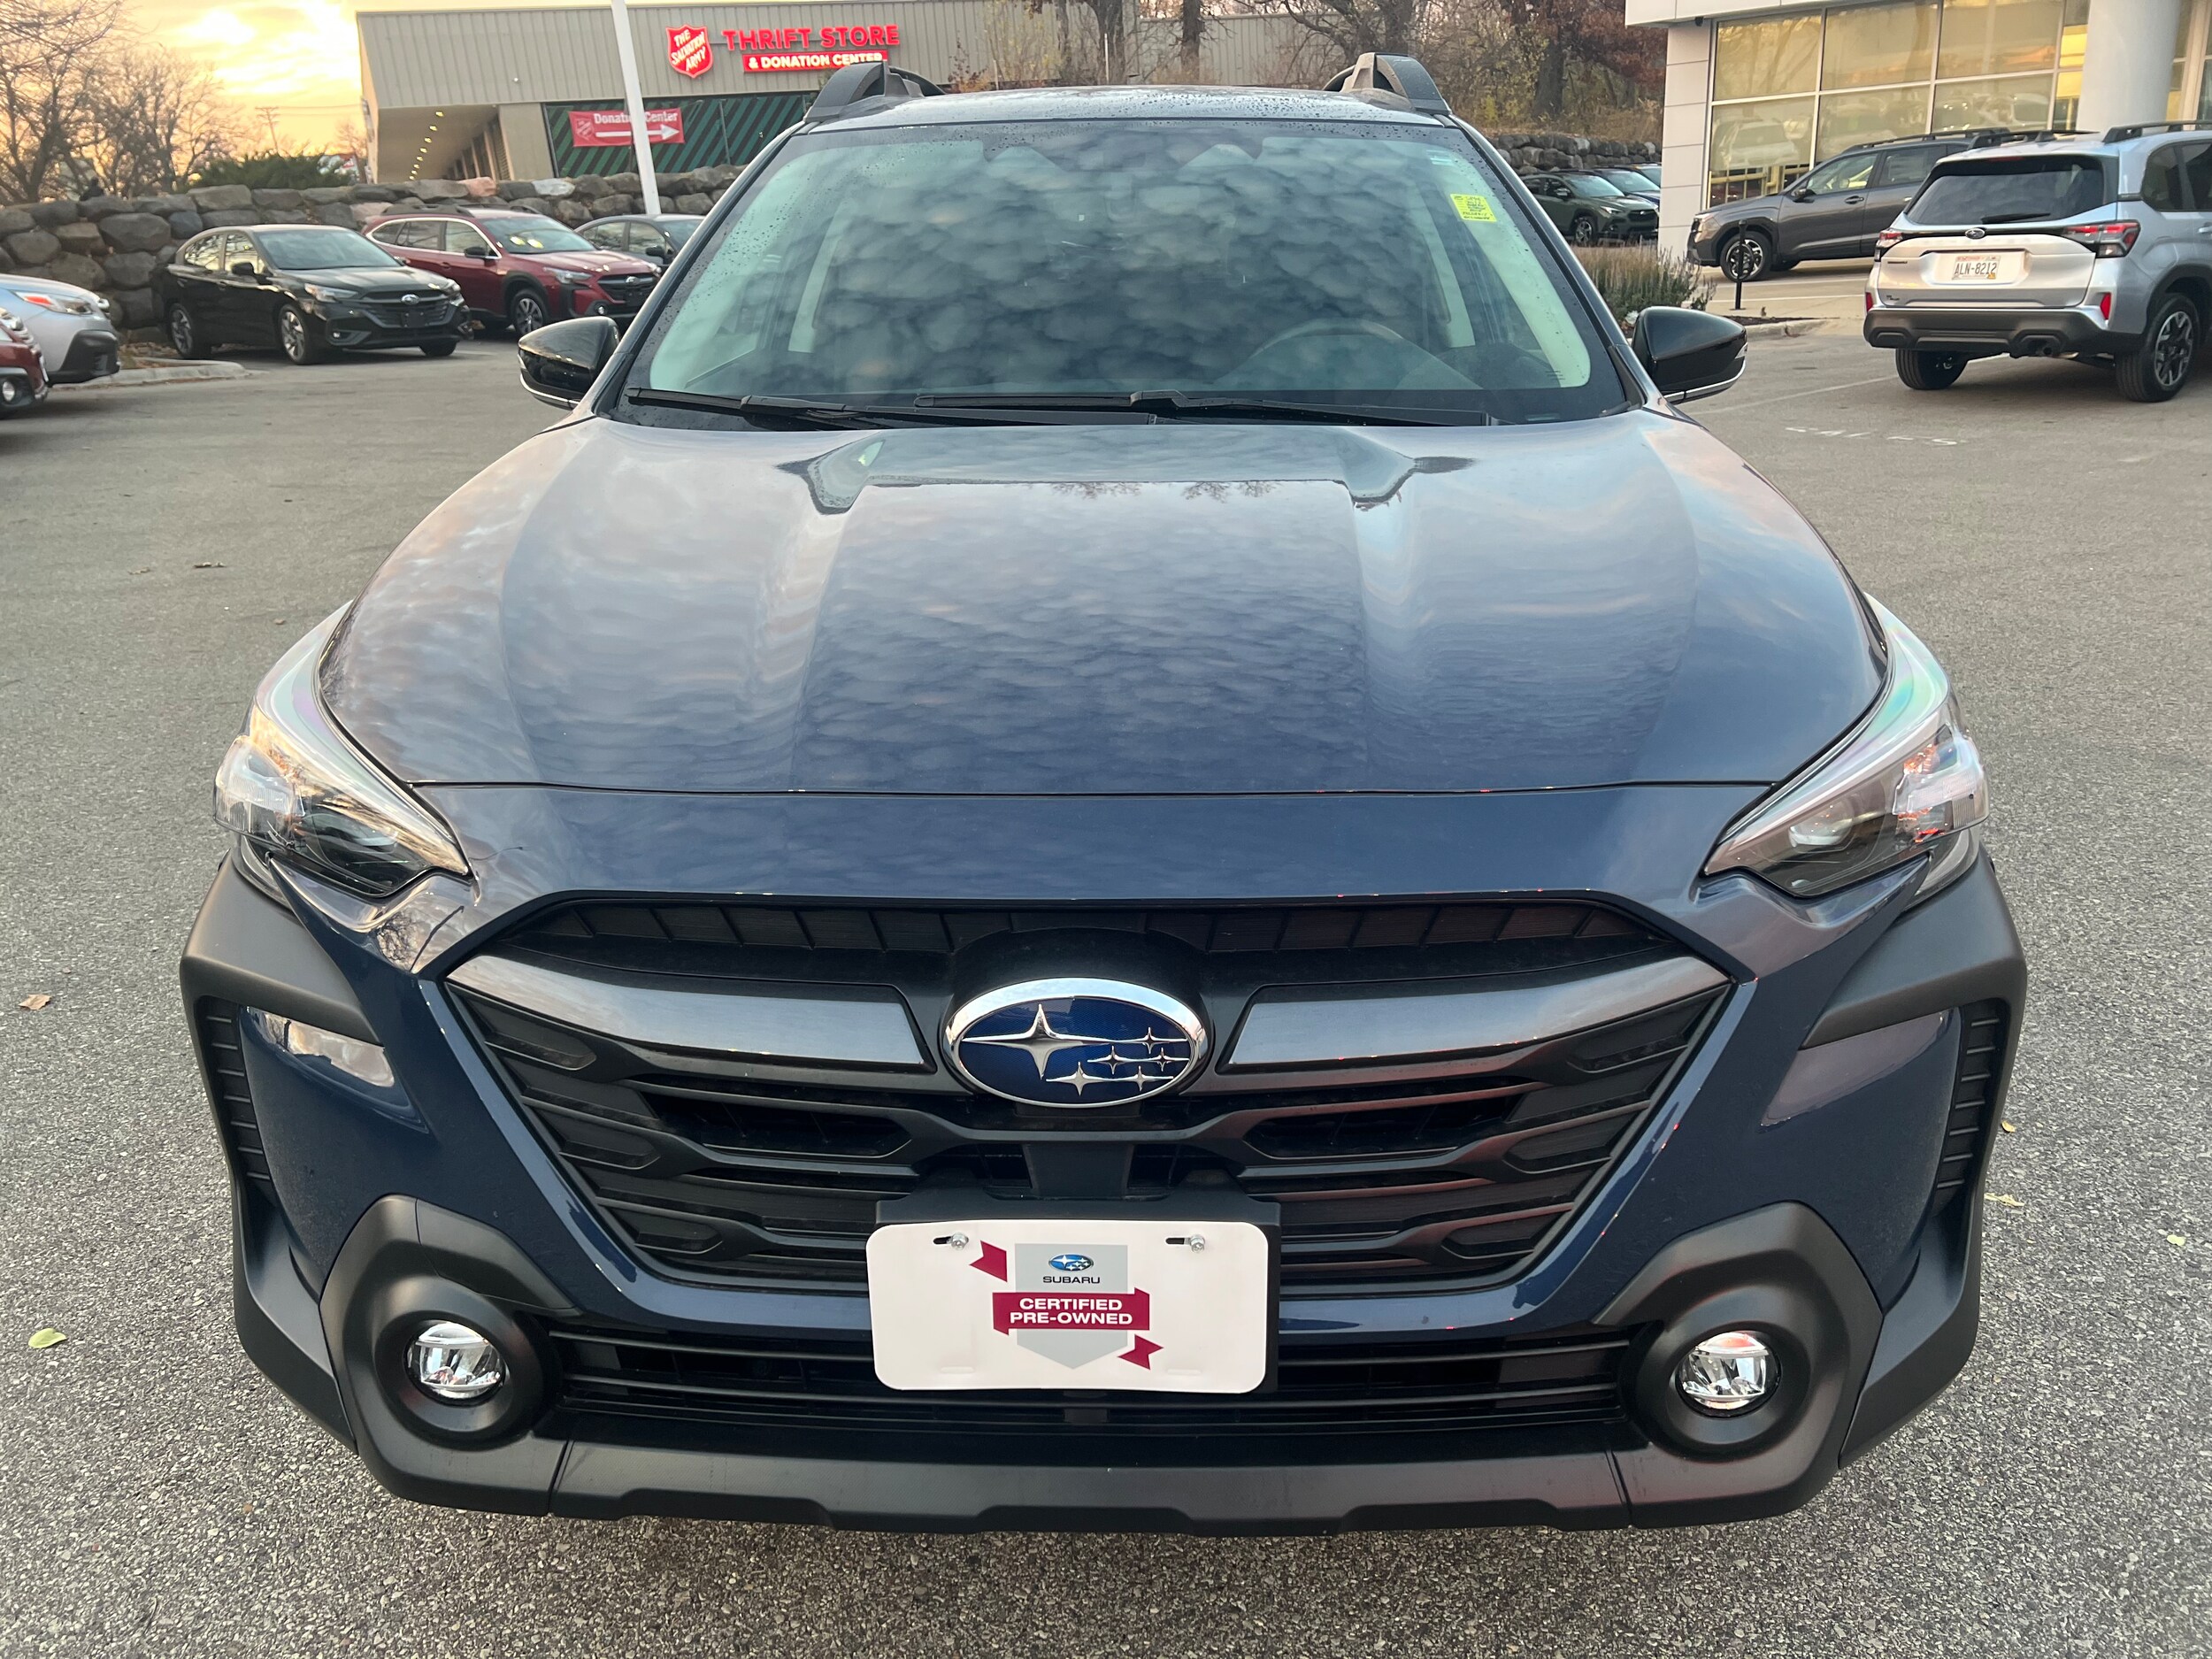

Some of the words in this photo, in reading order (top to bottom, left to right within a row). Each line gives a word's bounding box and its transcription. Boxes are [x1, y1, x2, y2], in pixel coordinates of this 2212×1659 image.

[673, 29, 690, 47] THE
[721, 27, 811, 50] THRIFT
[819, 24, 900, 49] STORE
[671, 31, 705, 65] SALVATION
[686, 45, 706, 71] ARMY
[748, 57, 758, 69] &
[761, 54, 830, 69] DONATION
[832, 52, 883, 65] CENTER
[1955, 262, 1997, 275] ALN-8212
[1019, 1298, 1123, 1310] CERTIFIED
[1010, 1312, 1133, 1325] PRE-OWNED
